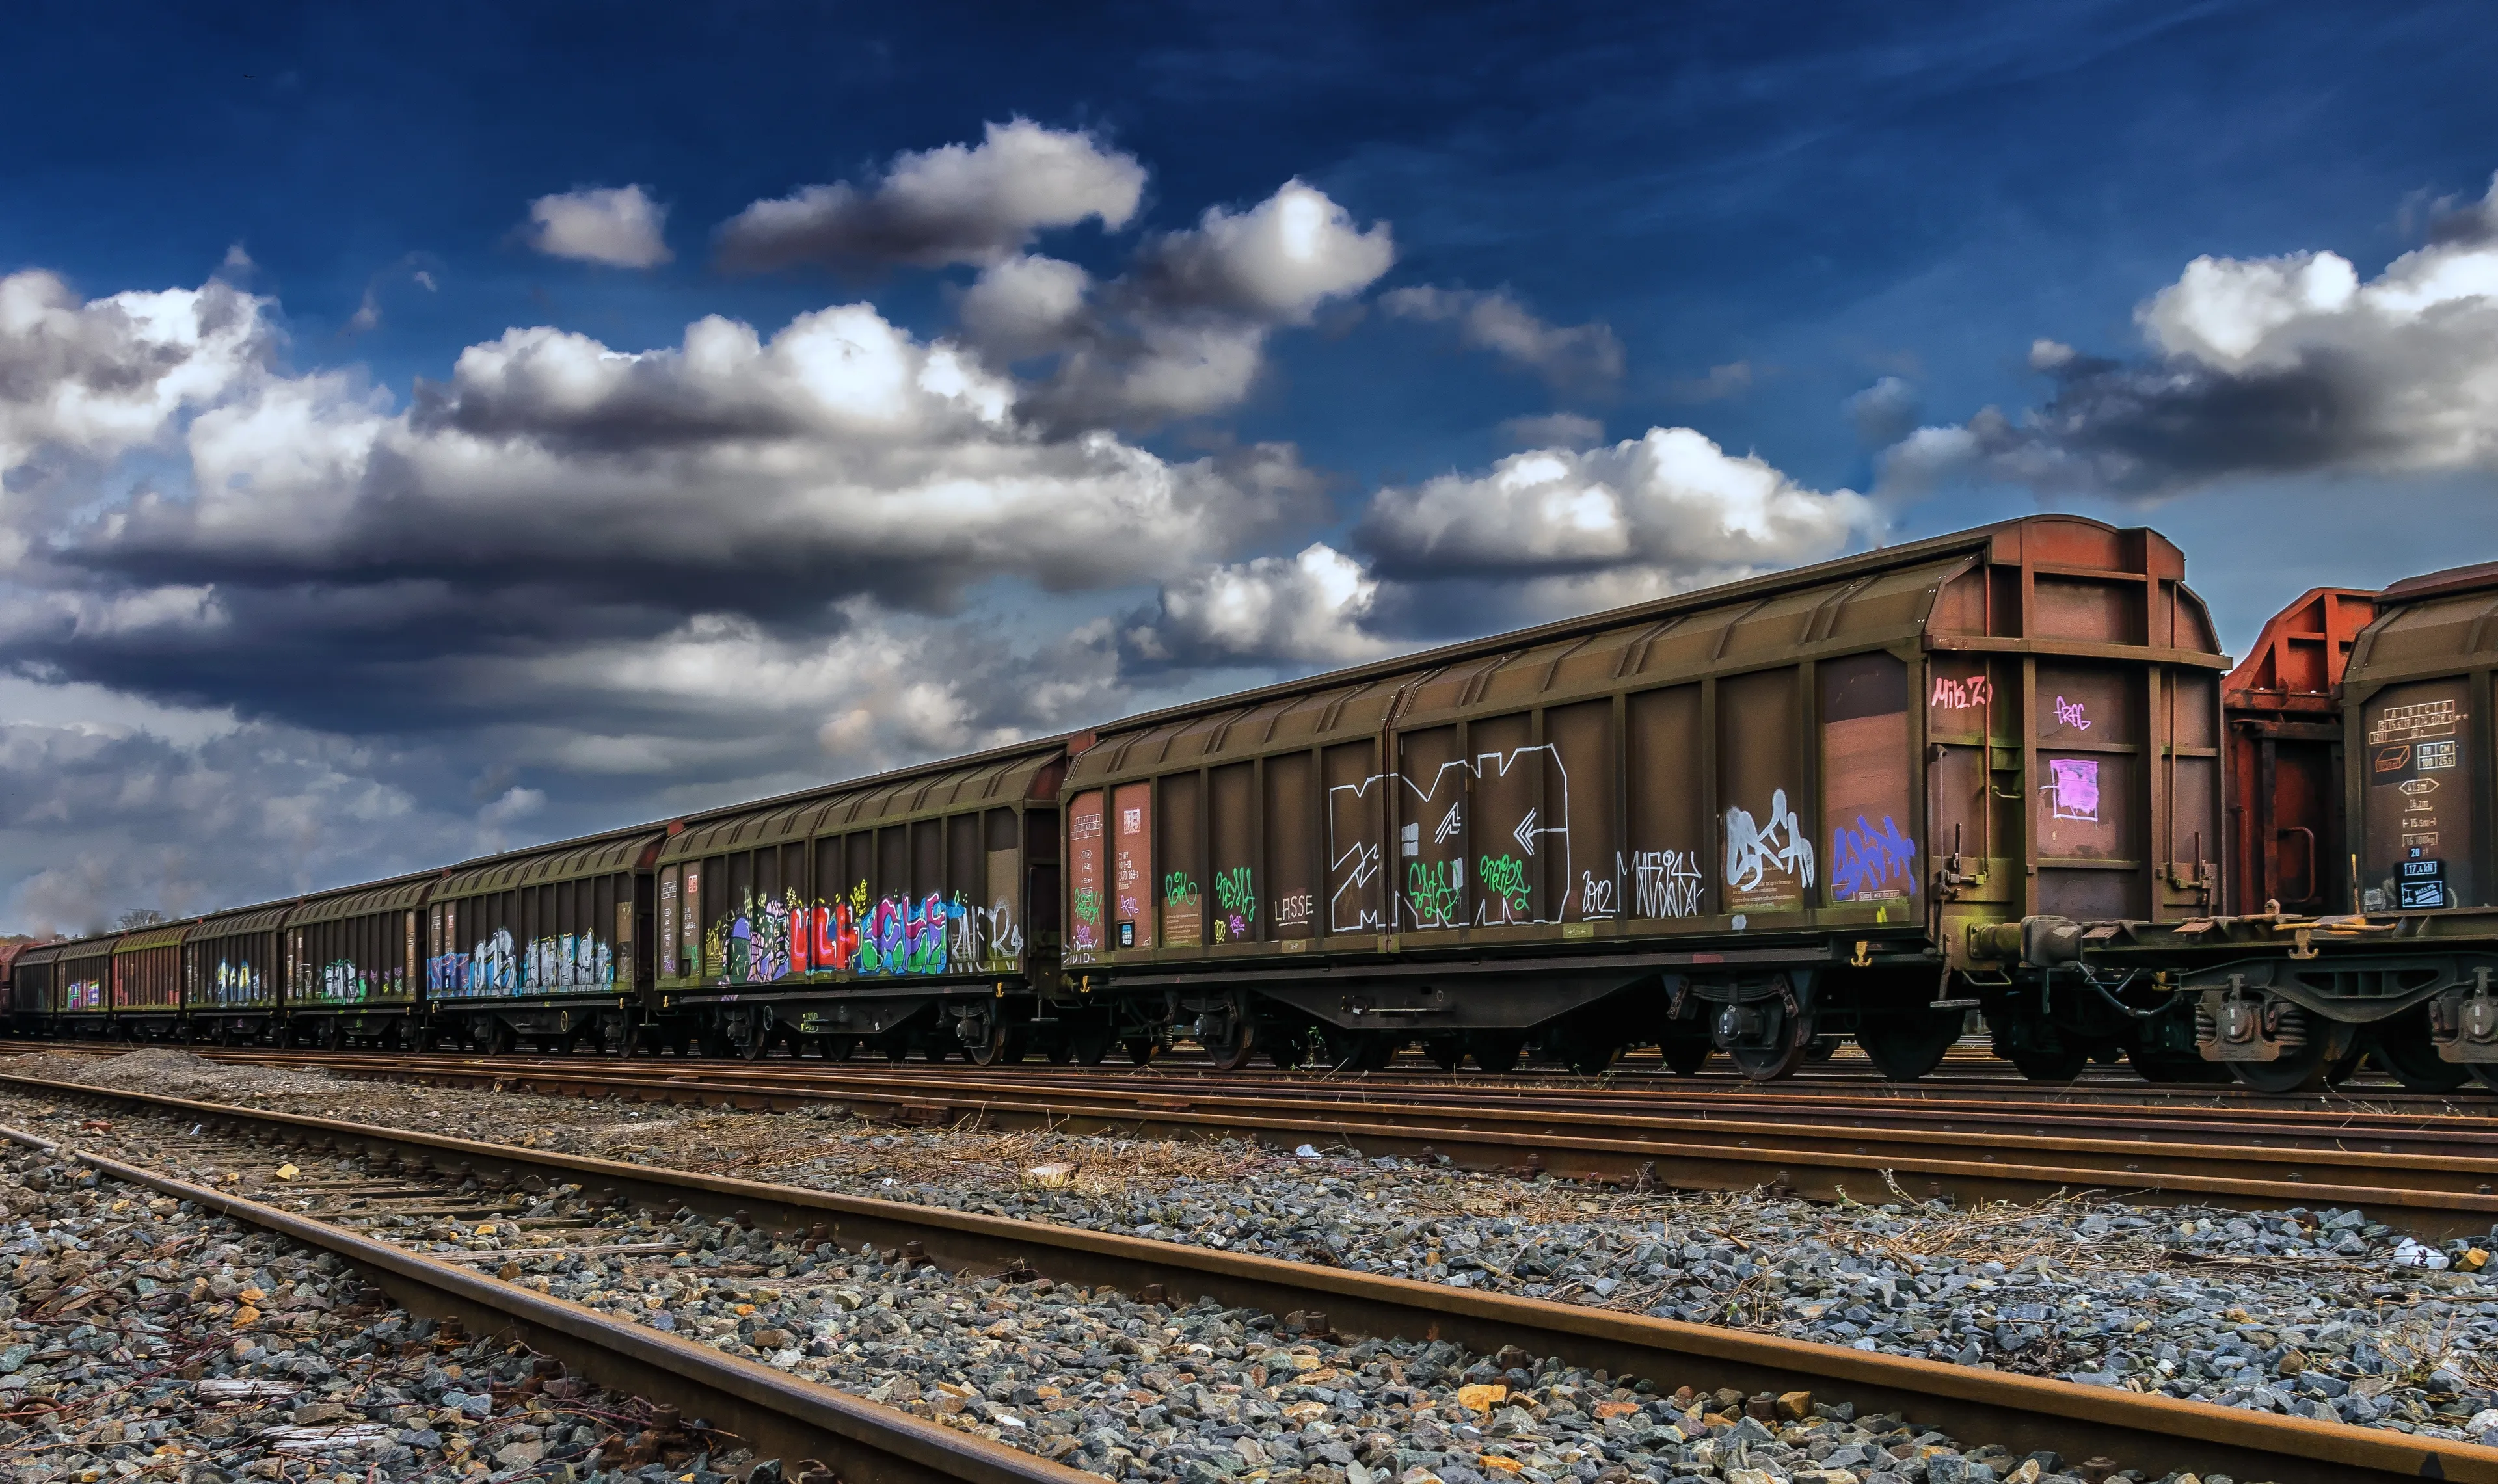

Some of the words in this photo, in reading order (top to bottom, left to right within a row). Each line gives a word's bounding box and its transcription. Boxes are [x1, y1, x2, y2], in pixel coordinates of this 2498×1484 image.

[2391, 709, 2397, 719] A
[2408, 707, 2413, 716] B
[2424, 705, 2430, 713] C
[2380, 722, 2385, 730] S
[2439, 744, 2451, 754] CM
[2421, 758, 2434, 767] 100
[2411, 848, 2420, 857] 20
[1274, 895, 1313, 921] LASSE
